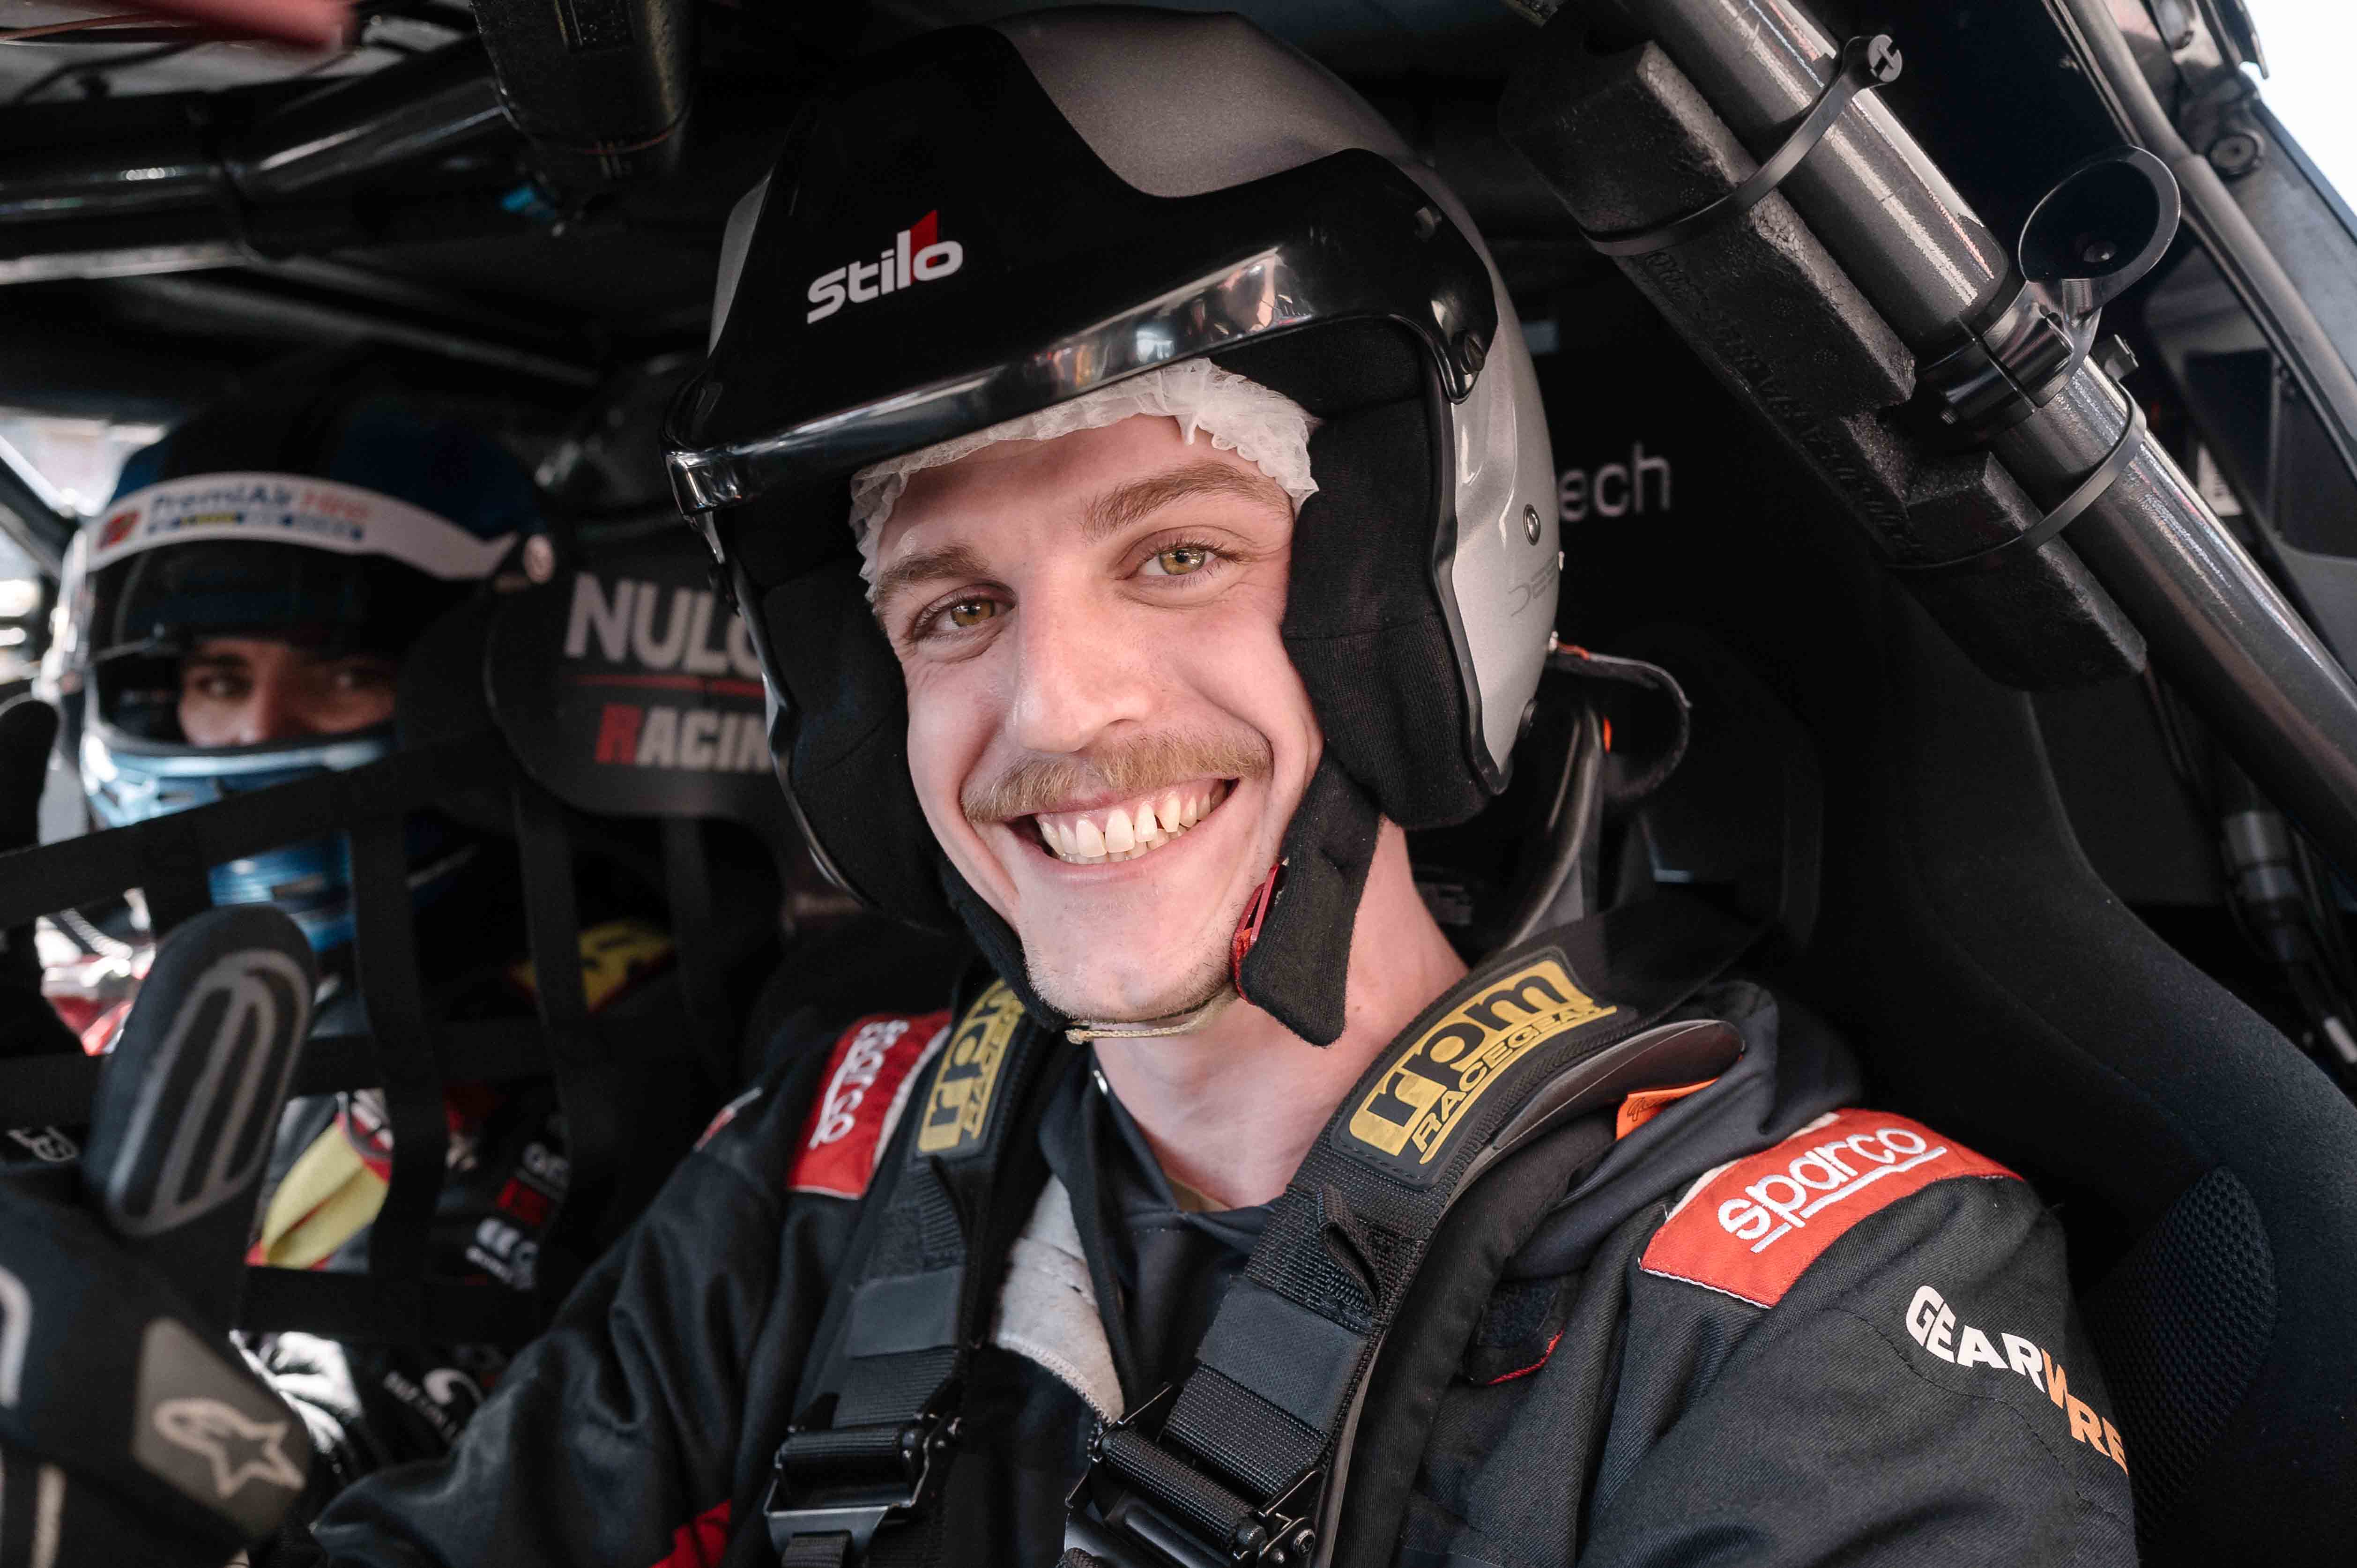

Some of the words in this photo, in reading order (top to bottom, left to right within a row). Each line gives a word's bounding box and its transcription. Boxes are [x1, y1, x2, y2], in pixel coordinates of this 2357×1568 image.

[1557, 439, 1672, 522] ech
[1366, 975, 1569, 1127] rpm
[1410, 1003, 1603, 1152] RACEGEAR
[1718, 1128, 1926, 1240] sparco
